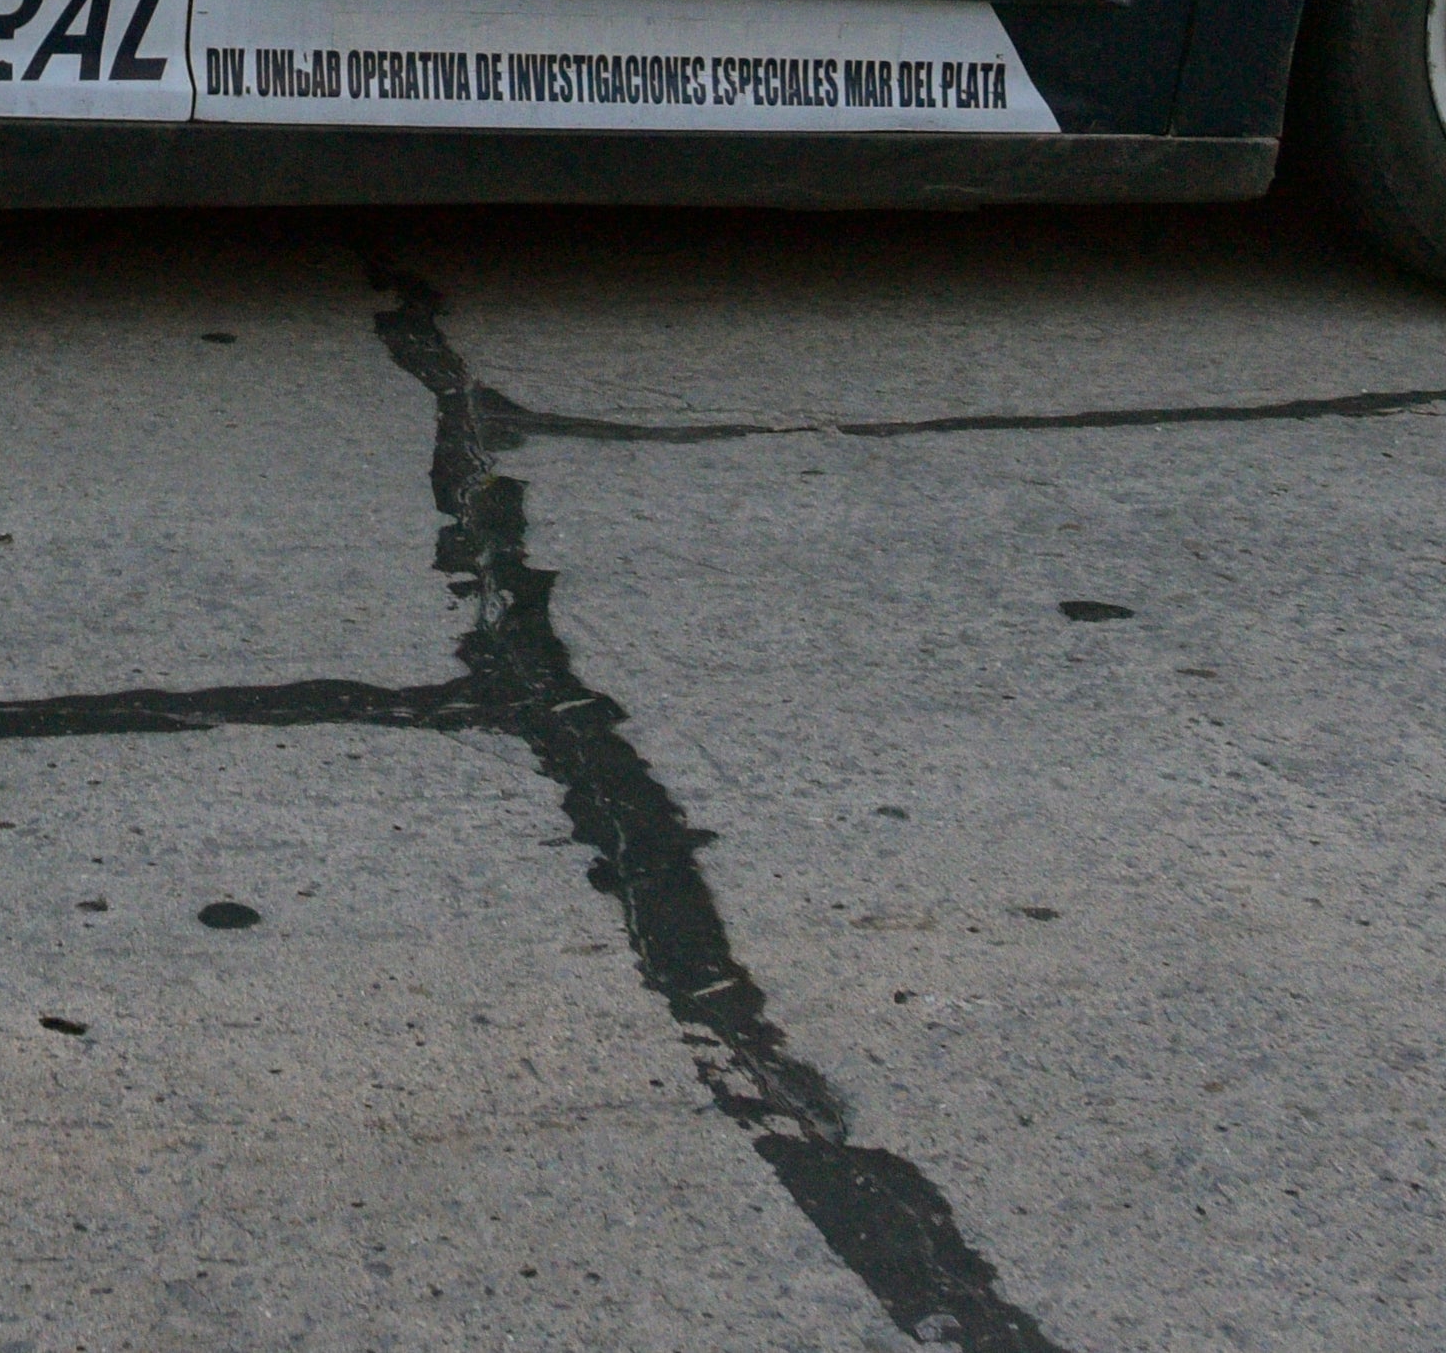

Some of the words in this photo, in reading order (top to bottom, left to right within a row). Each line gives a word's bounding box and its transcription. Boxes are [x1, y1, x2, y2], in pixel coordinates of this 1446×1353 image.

[207, 48, 251, 97] DIV.
[347, 50, 470, 101] OPERATIVA
[476, 53, 503, 101] DE
[510, 53, 705, 105] INVESTIGACIONES
[712, 57, 838, 108] ESPECIALES
[844, 59, 893, 109] MAR
[898, 60, 936, 109] DEL
[942, 62, 1007, 110] PLATA
